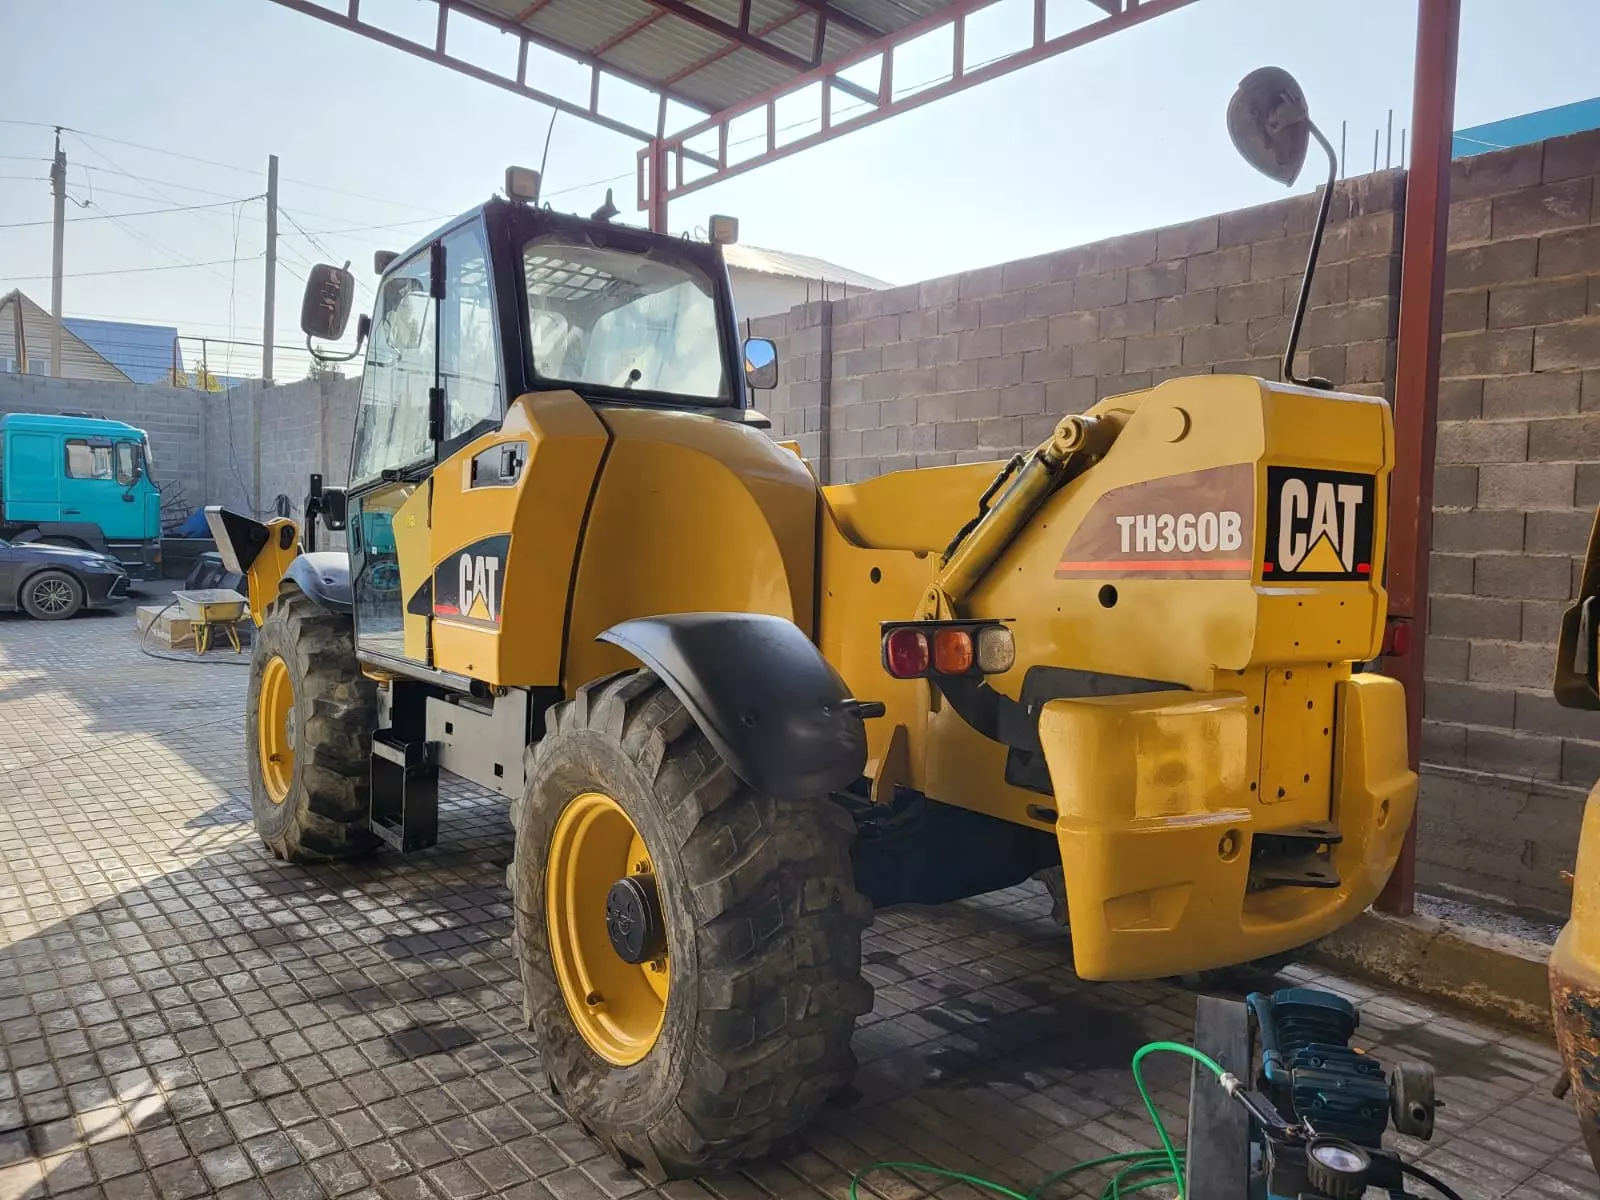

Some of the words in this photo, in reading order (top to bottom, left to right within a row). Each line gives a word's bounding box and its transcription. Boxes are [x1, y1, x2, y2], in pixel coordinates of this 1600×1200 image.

[1116, 511, 1242, 553] TH360B
[1278, 478, 1363, 572] CAT
[459, 553, 498, 621] CAT
